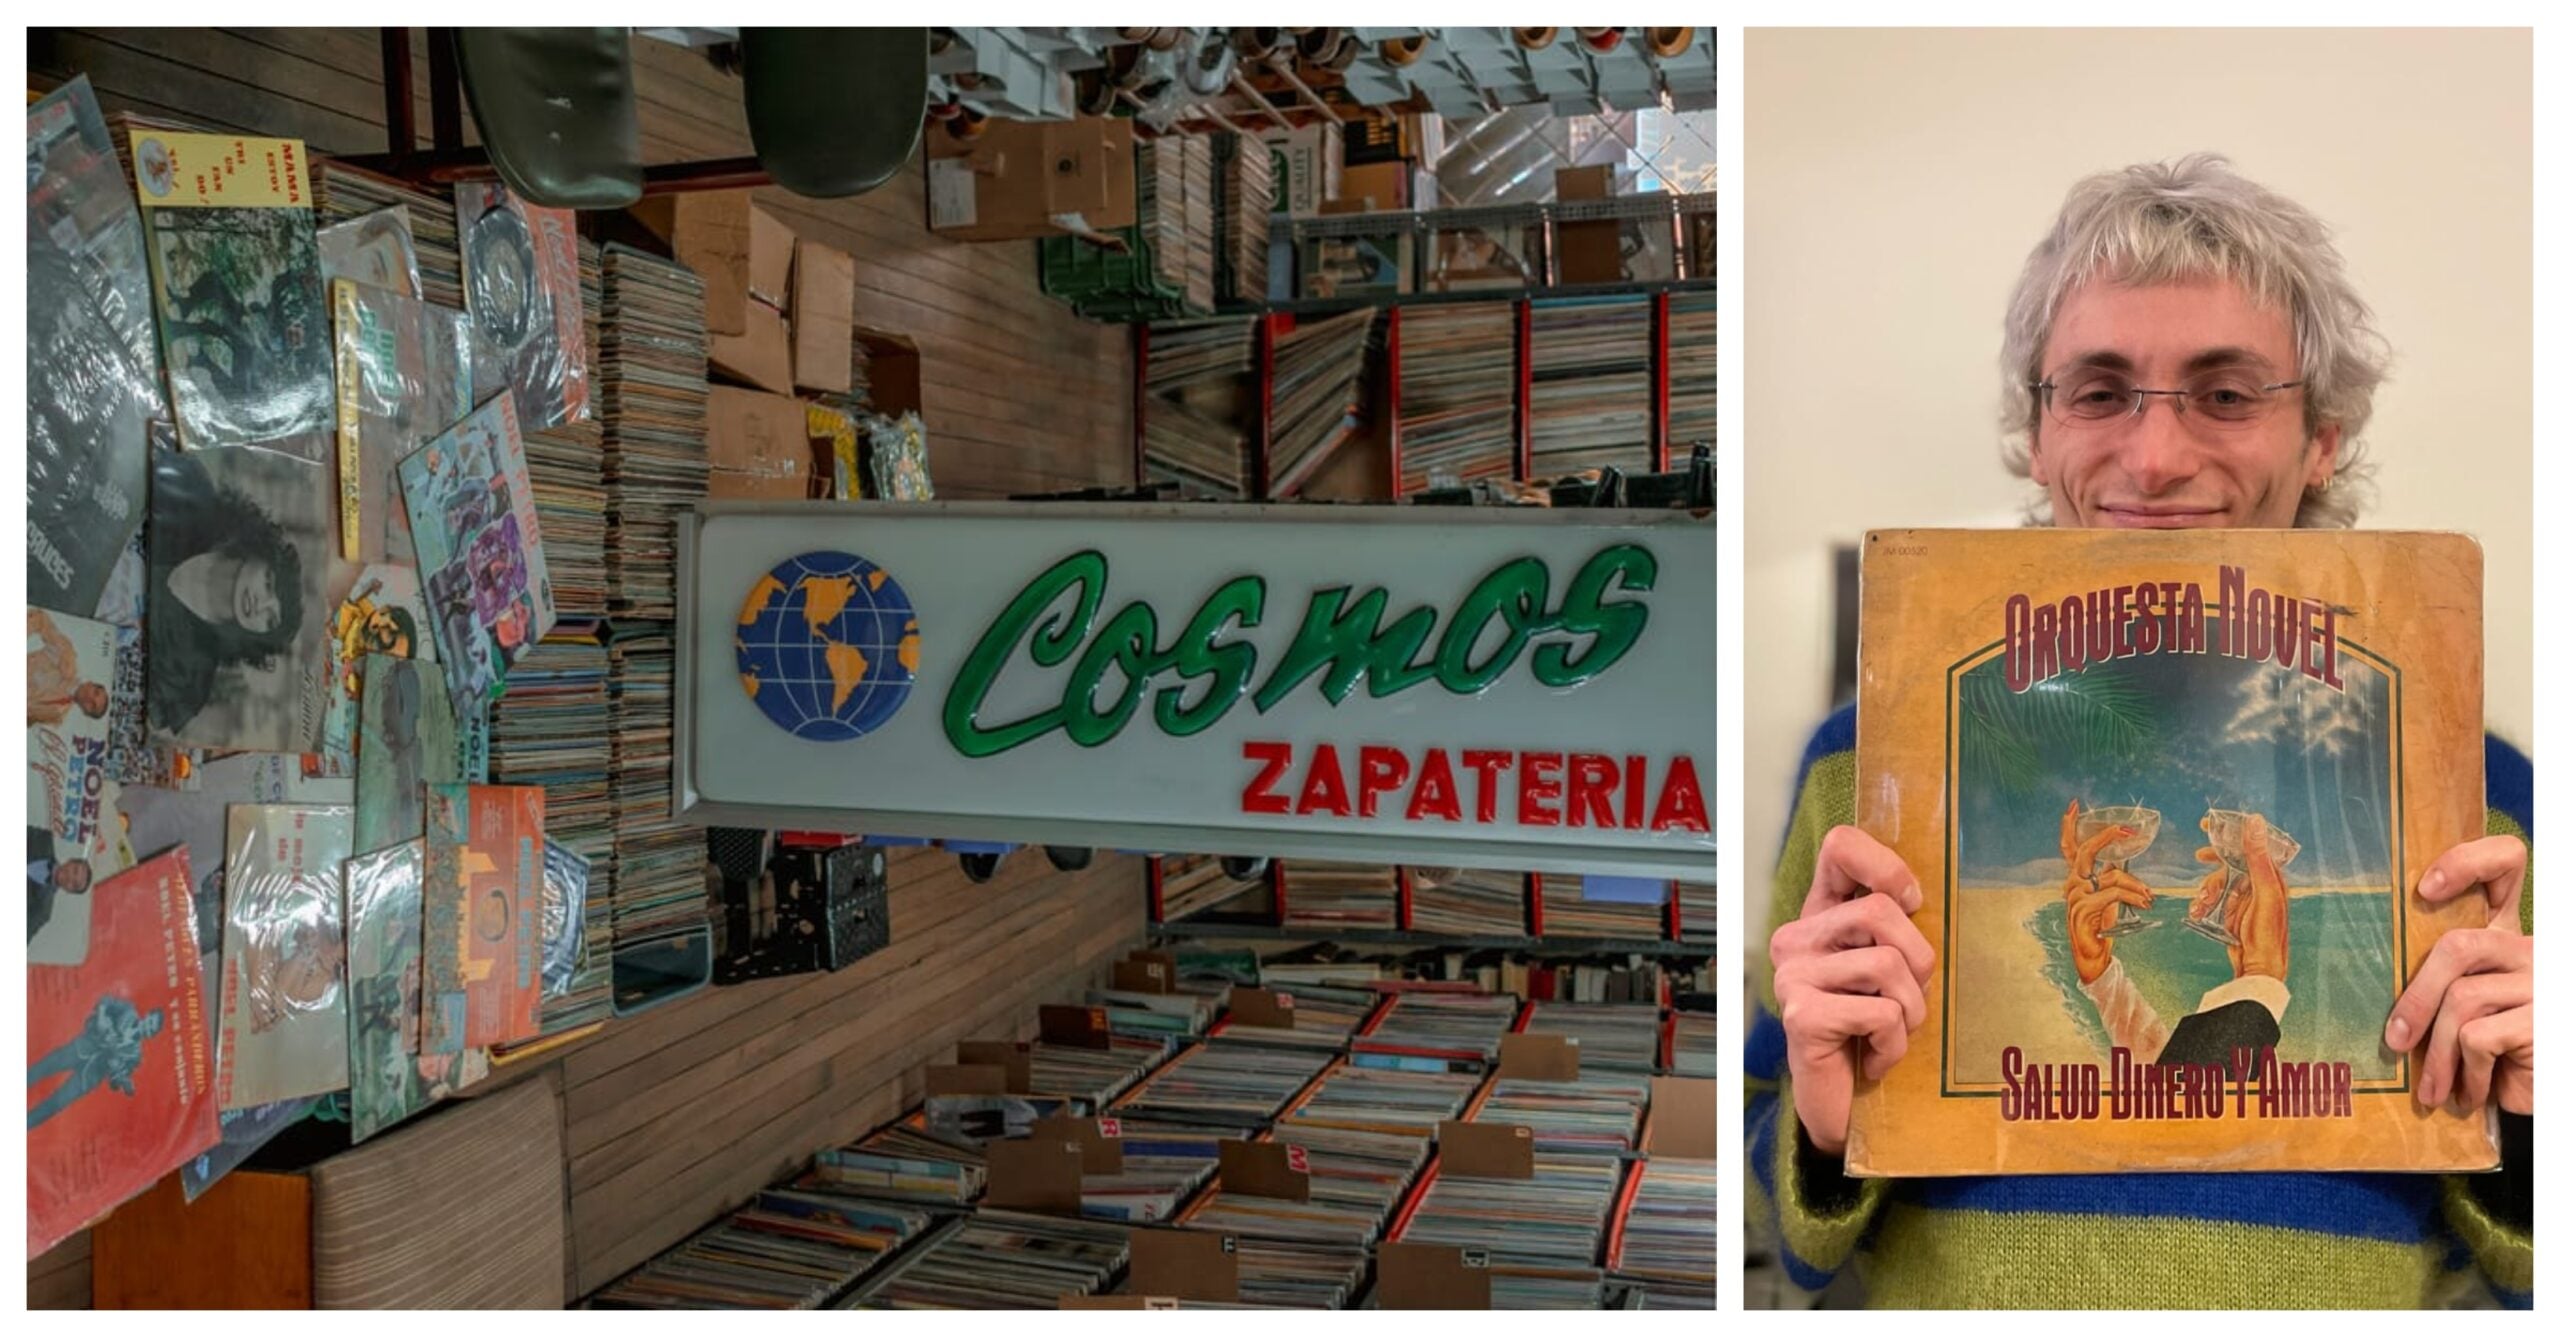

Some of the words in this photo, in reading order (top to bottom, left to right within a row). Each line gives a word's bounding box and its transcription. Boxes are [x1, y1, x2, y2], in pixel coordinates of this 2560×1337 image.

[265, 152, 280, 193] ESTOY
[282, 144, 299, 204] MAMA
[941, 543, 1659, 758] Cosmos
[2003, 581, 2207, 695] ORQUESTA
[2218, 564, 2345, 696] NOVEL
[61, 735, 87, 843] PETRO
[78, 738, 107, 845] NOEL
[1240, 740, 1713, 835] ZAPATERIA
[2000, 1045, 2100, 1122] SALUD
[2110, 1046, 2226, 1121] DINERO
[2230, 1043, 2253, 1120] Y
[2258, 1045, 2353, 1120] AMOR
